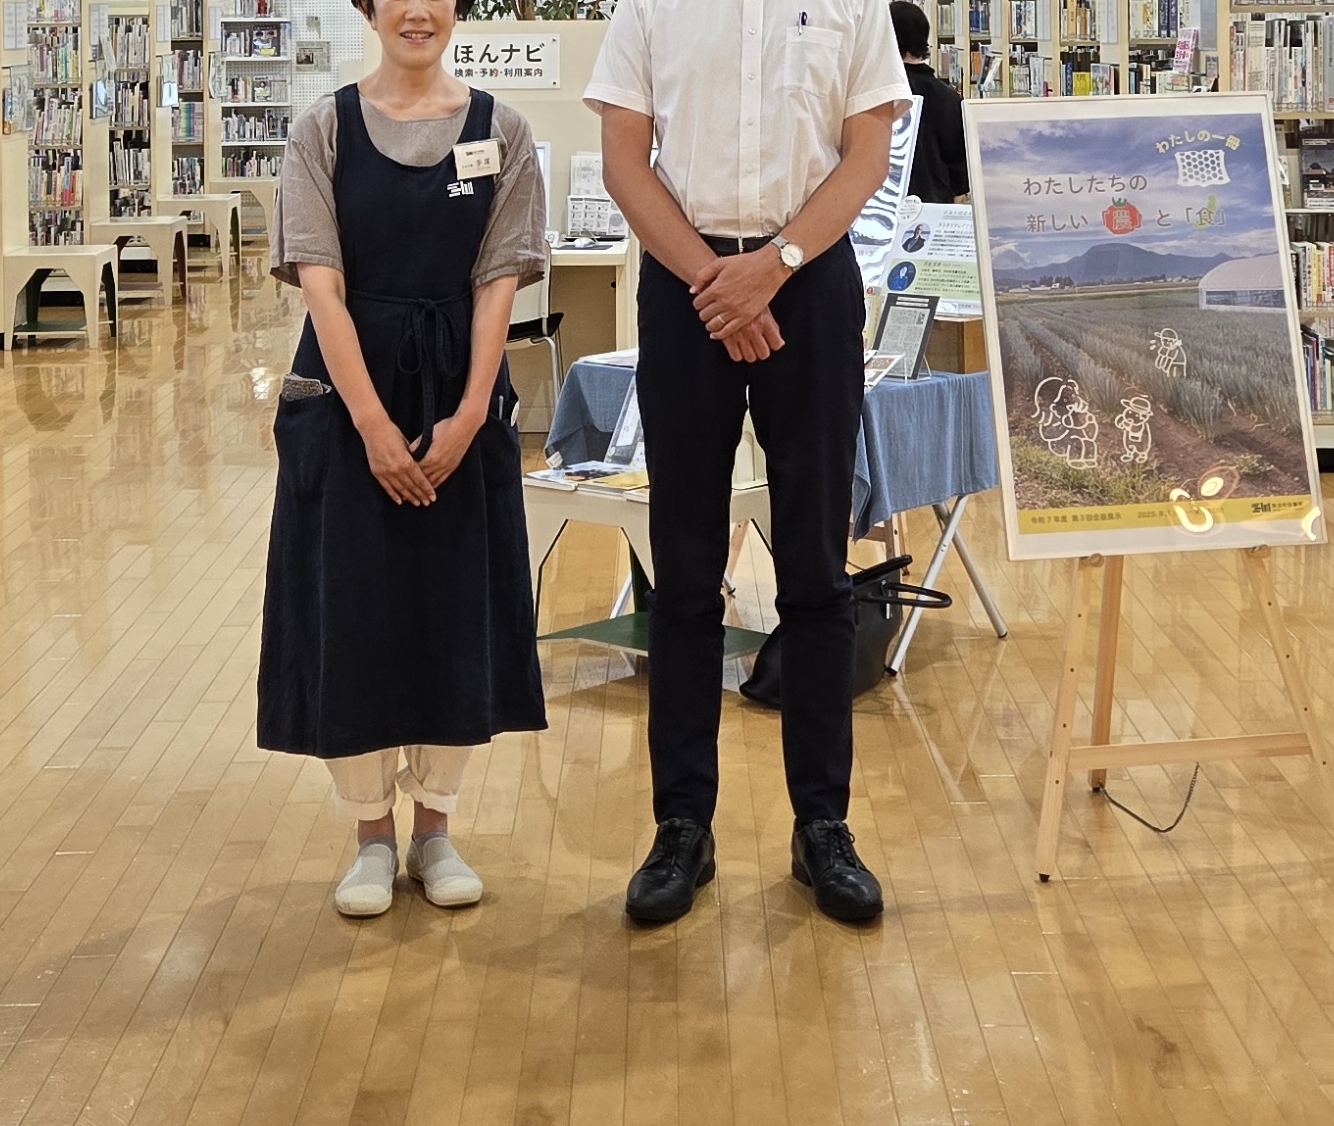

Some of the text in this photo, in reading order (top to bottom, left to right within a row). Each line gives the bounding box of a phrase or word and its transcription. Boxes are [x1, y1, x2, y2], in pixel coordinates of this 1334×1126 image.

[454, 42, 545, 64] ほんナビ
[1023, 174, 1147, 197] わたしたちの
